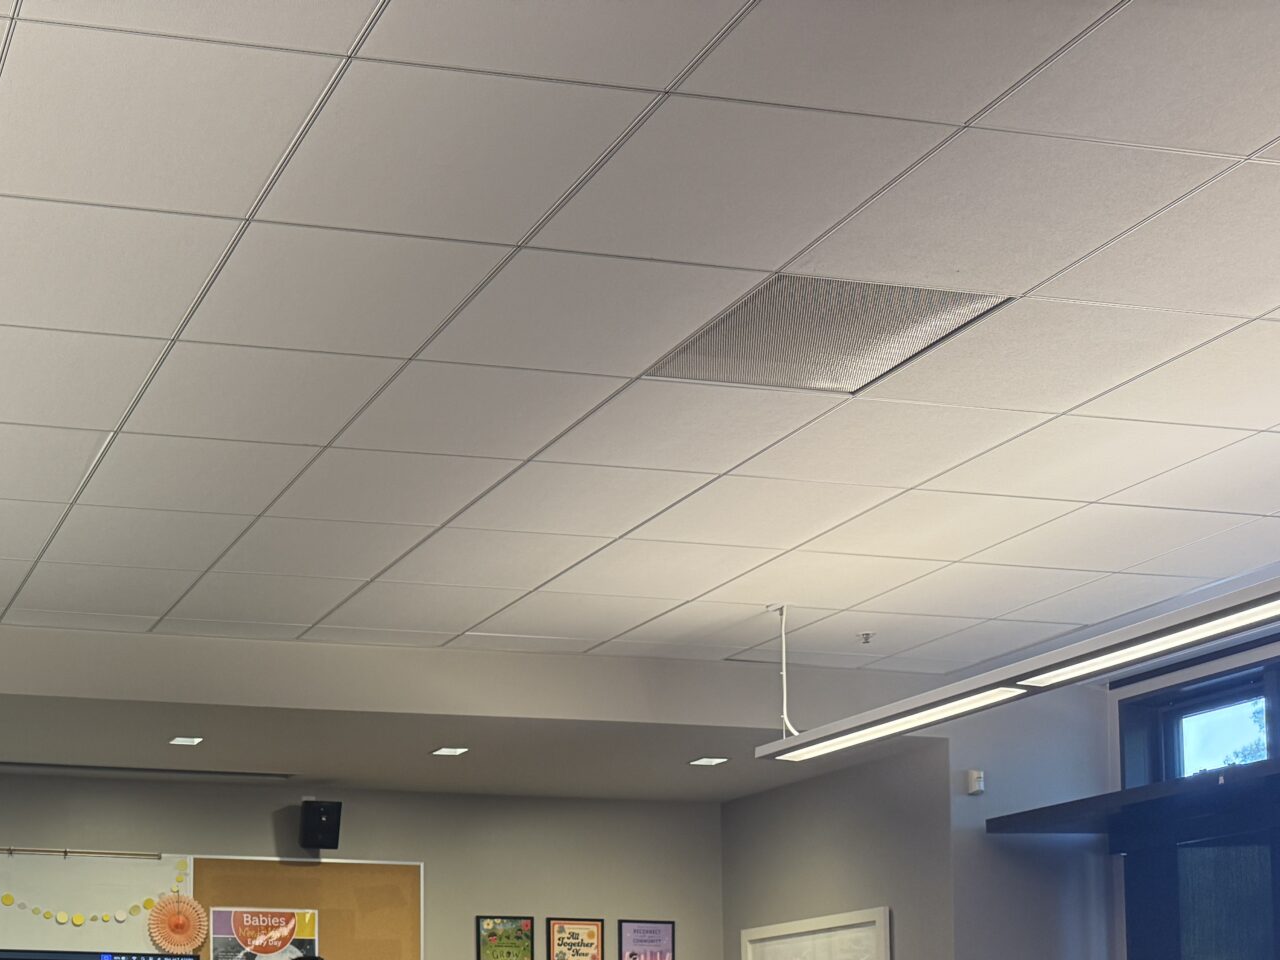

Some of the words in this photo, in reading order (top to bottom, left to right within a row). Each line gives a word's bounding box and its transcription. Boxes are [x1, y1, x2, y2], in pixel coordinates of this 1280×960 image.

[243, 913, 286, 926] Babies
[567, 932, 579, 940] All
[268, 939, 282, 947] Day
[557, 937, 595, 951] Together
[572, 949, 589, 957] Now
